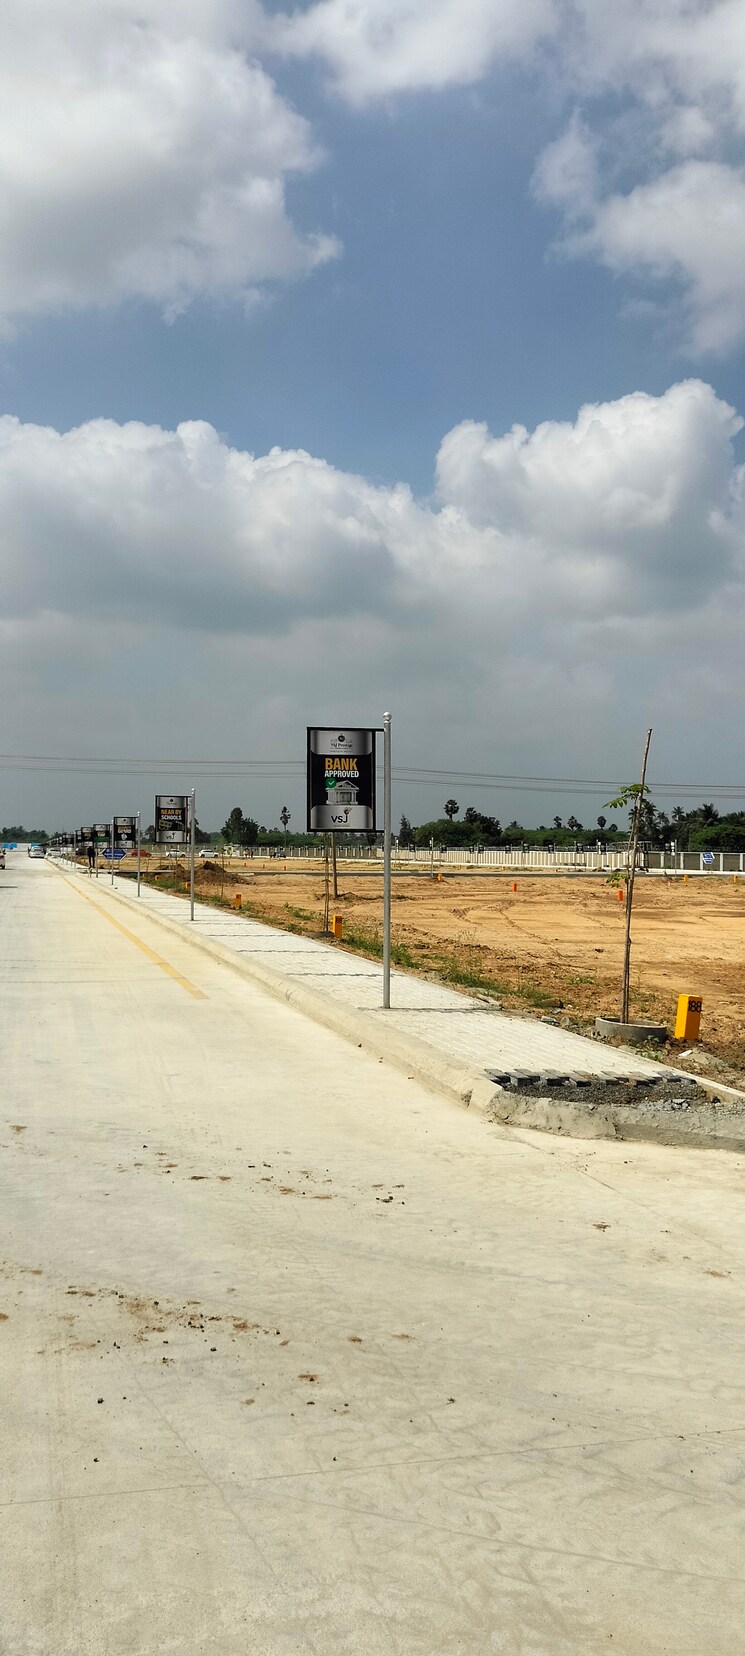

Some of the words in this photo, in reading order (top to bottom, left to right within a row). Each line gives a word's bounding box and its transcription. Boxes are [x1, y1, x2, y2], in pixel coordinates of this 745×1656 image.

[325, 757, 358, 771] BANK
[324, 770, 359, 778] APPROVED
[331, 813, 348, 823] VSJ
